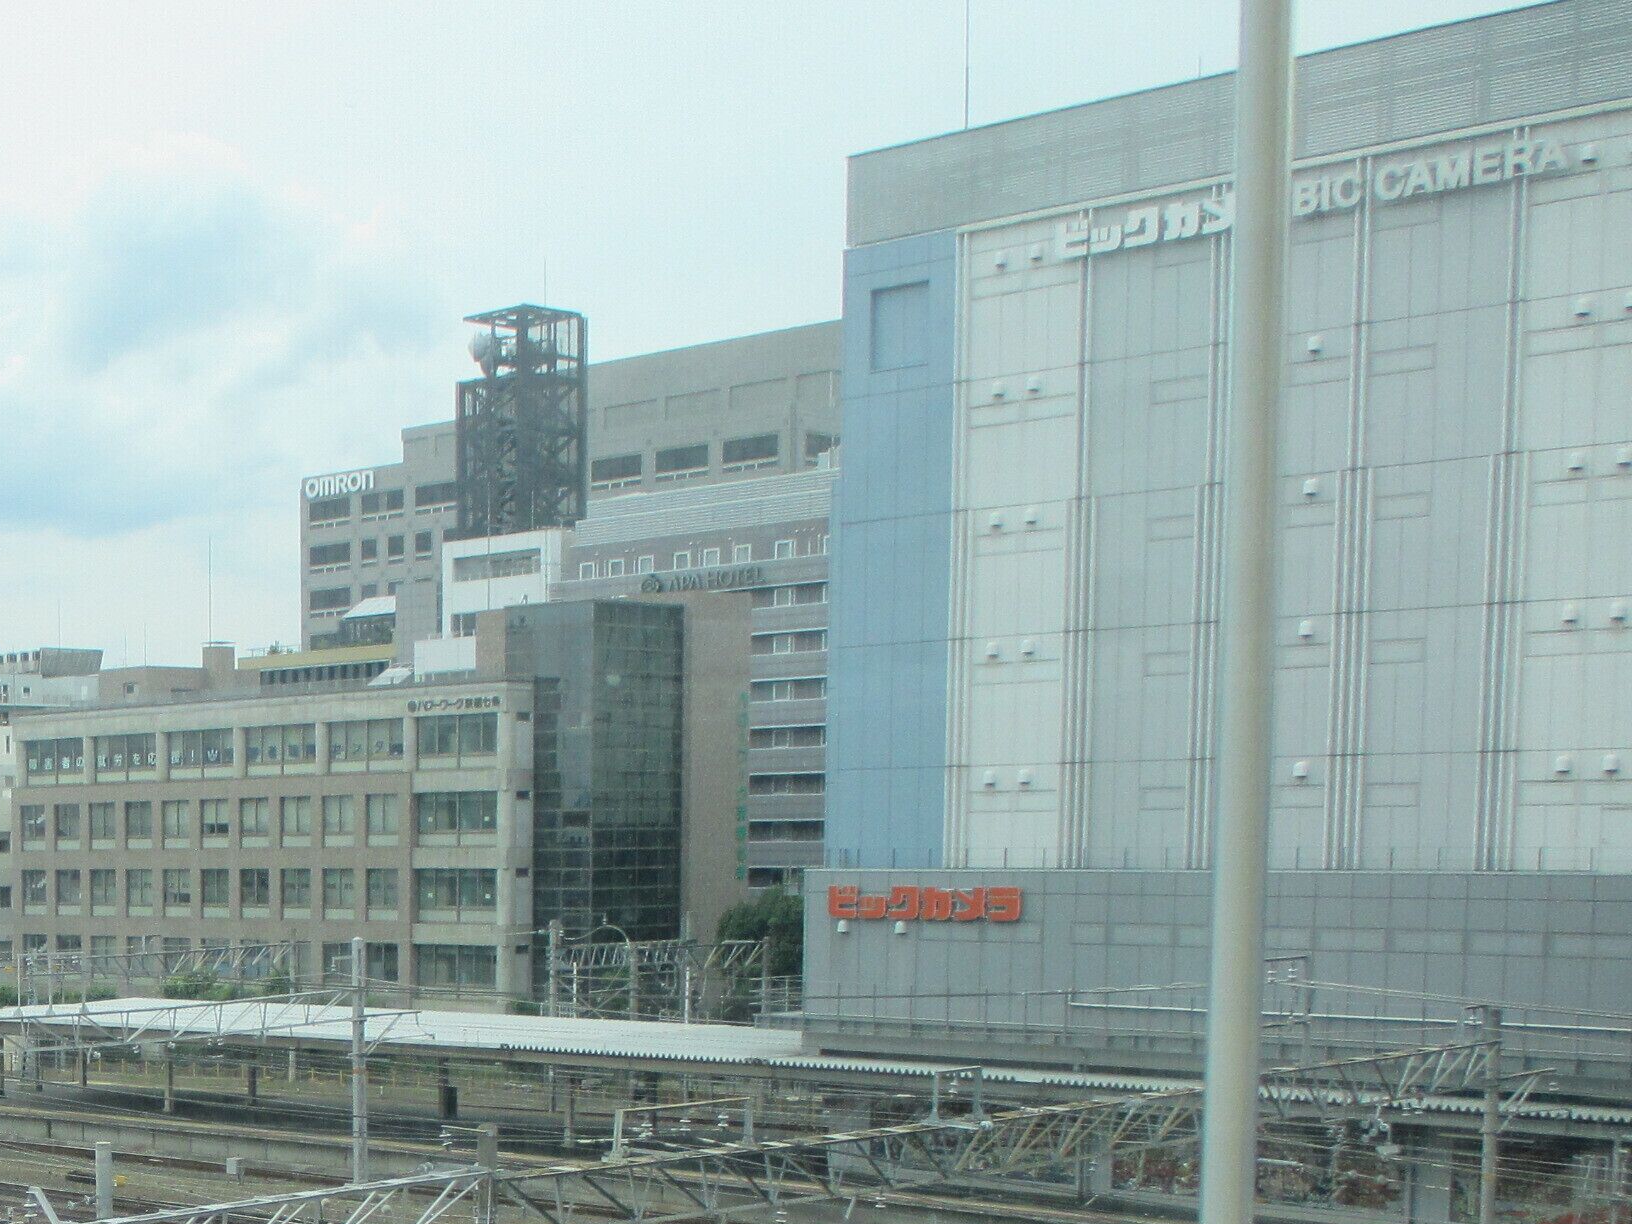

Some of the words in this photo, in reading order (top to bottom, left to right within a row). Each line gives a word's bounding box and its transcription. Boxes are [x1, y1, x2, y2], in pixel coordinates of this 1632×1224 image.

[1055, 190, 1236, 259] ビックカメ
[1291, 168, 1364, 217] BIC
[1373, 139, 1566, 202] CAMERA
[670, 572, 703, 592] APA
[707, 566, 765, 588] HOTEL
[828, 885, 1023, 922] ビックカメラ
